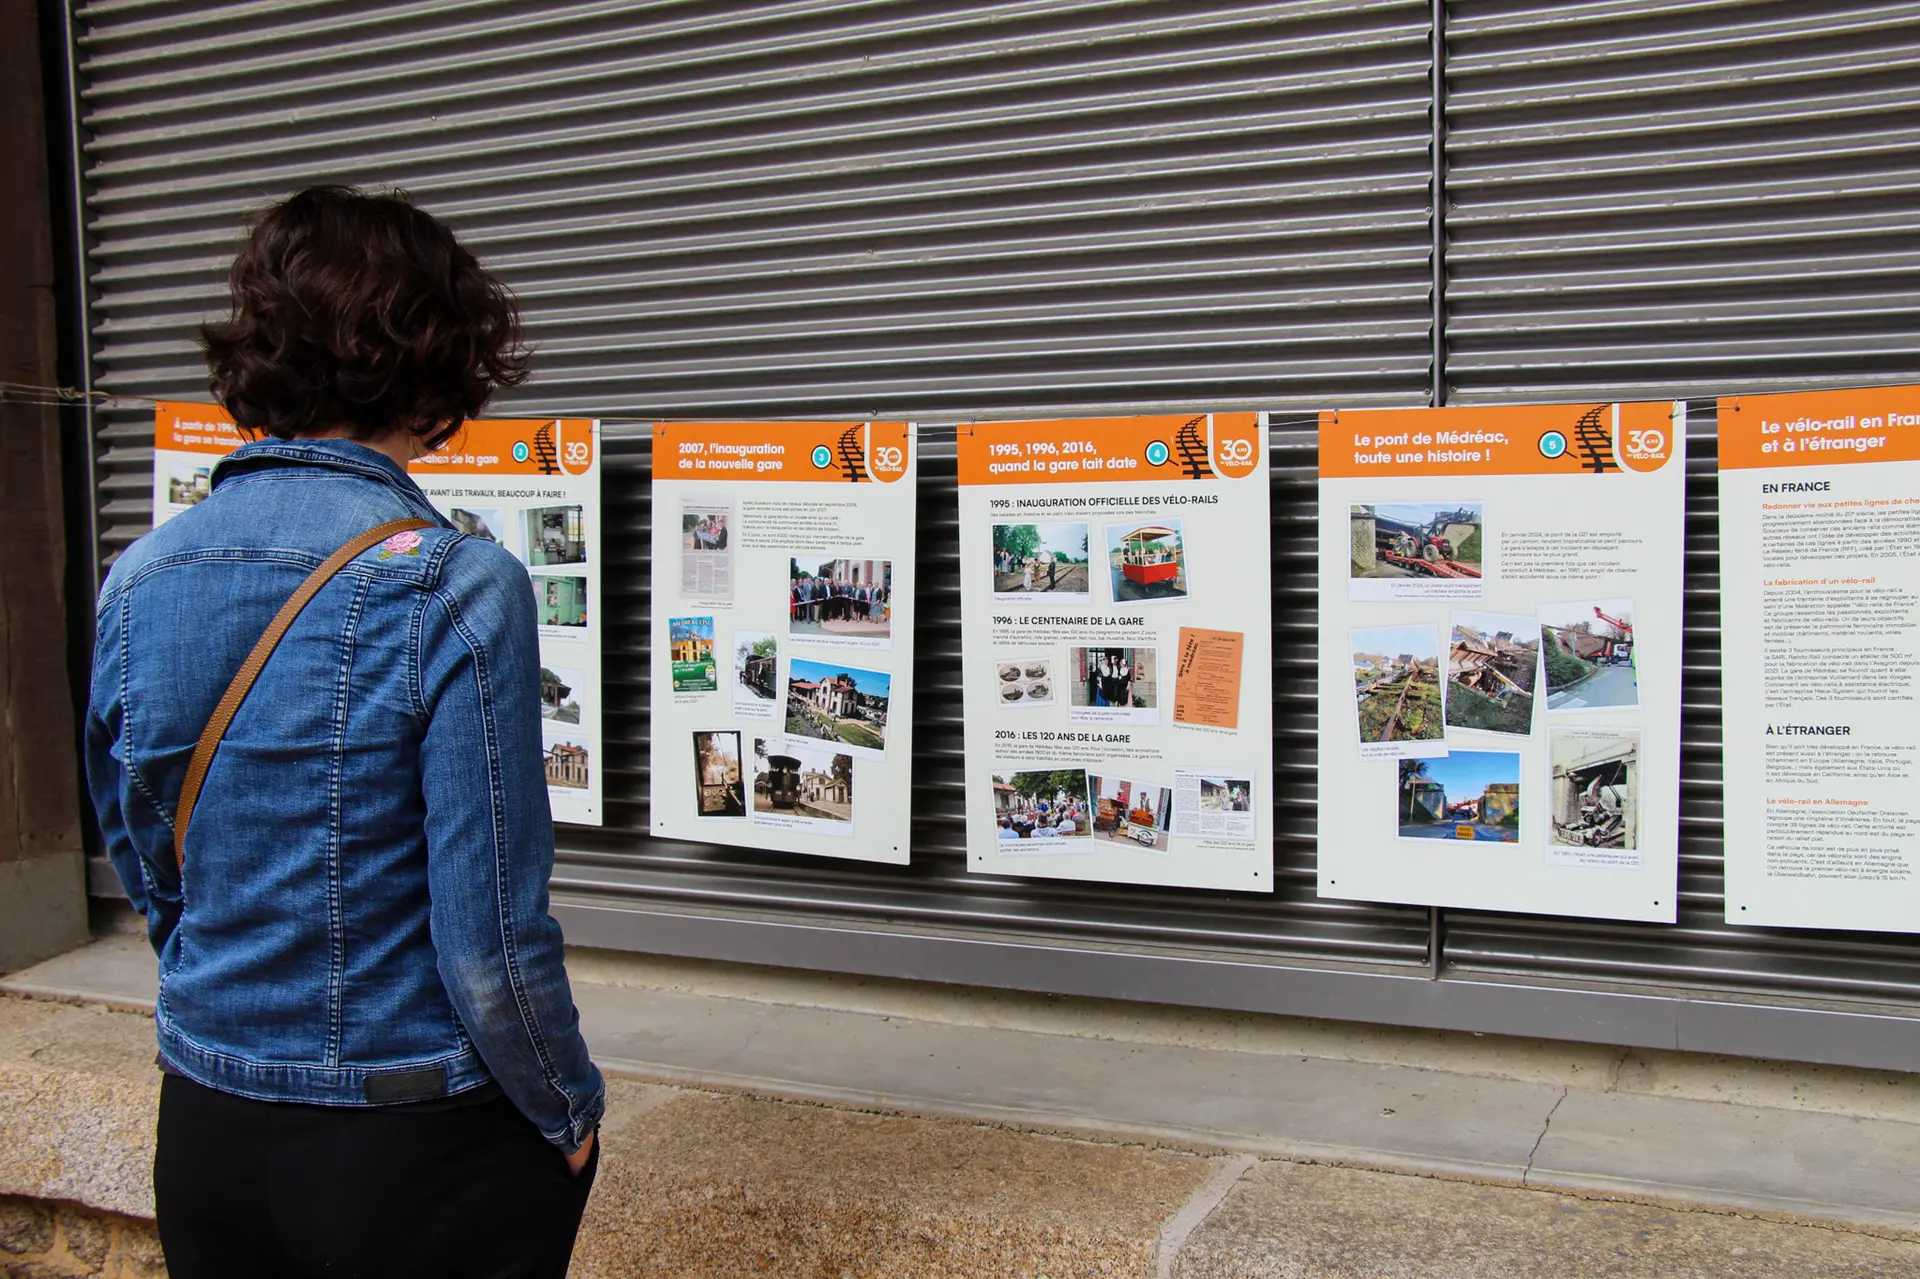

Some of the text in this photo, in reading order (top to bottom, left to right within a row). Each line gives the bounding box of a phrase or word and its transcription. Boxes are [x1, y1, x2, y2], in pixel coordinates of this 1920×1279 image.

[1762, 421, 1780, 434] Le
[1785, 416, 1854, 432] vélo-rail
[1860, 417, 1882, 428] en
[1355, 430, 1508, 448] Le pont de Médréac,
[1549, 440, 1556, 450] 5
[1626, 430, 1664, 453] 30
[1761, 436, 1886, 453] et à l'étranger
[679, 443, 785, 457] 2007, l'inauguration
[874, 446, 902, 466] 30
[990, 441, 1097, 457] 1995, 1996, 2016,
[1154, 450, 1160, 458] 4
[1220, 439, 1252, 460] 30
[452, 454, 463, 464] de
[466, 454, 474, 464] la
[476, 456, 499, 466] gare
[1354, 449, 1490, 464] toute une histoire !
[679, 458, 783, 472] de la nouvelle gare
[989, 457, 1137, 475] quand la gare fait date
[536, 489, 541, 497] À
[1763, 482, 1830, 493] EN FRANCE
[990, 500, 1010, 508] 1995
[1017, 498, 1086, 507] INAUGURATION
[1088, 497, 1140, 506] OFFICIELLE
[1142, 496, 1160, 505] DES
[1162, 494, 1218, 504] VÉLO-RAILS
[1834, 501, 1862, 509] petites
[1864, 500, 1889, 508] lignes
[993, 616, 1012, 624] 1996
[1031, 617, 1088, 625] CENTENAIRE
[1091, 617, 1102, 625] DE
[1119, 617, 1144, 626] GARE
[995, 730, 1016, 739] 2016
[1023, 732, 1038, 740] LES
[1040, 732, 1055, 740] 120
[1057, 733, 1076, 741] ANS
[1078, 733, 1090, 742] DE
[1105, 734, 1130, 743] GARE
[1766, 724, 1850, 735] À L'ÉTRANGER
